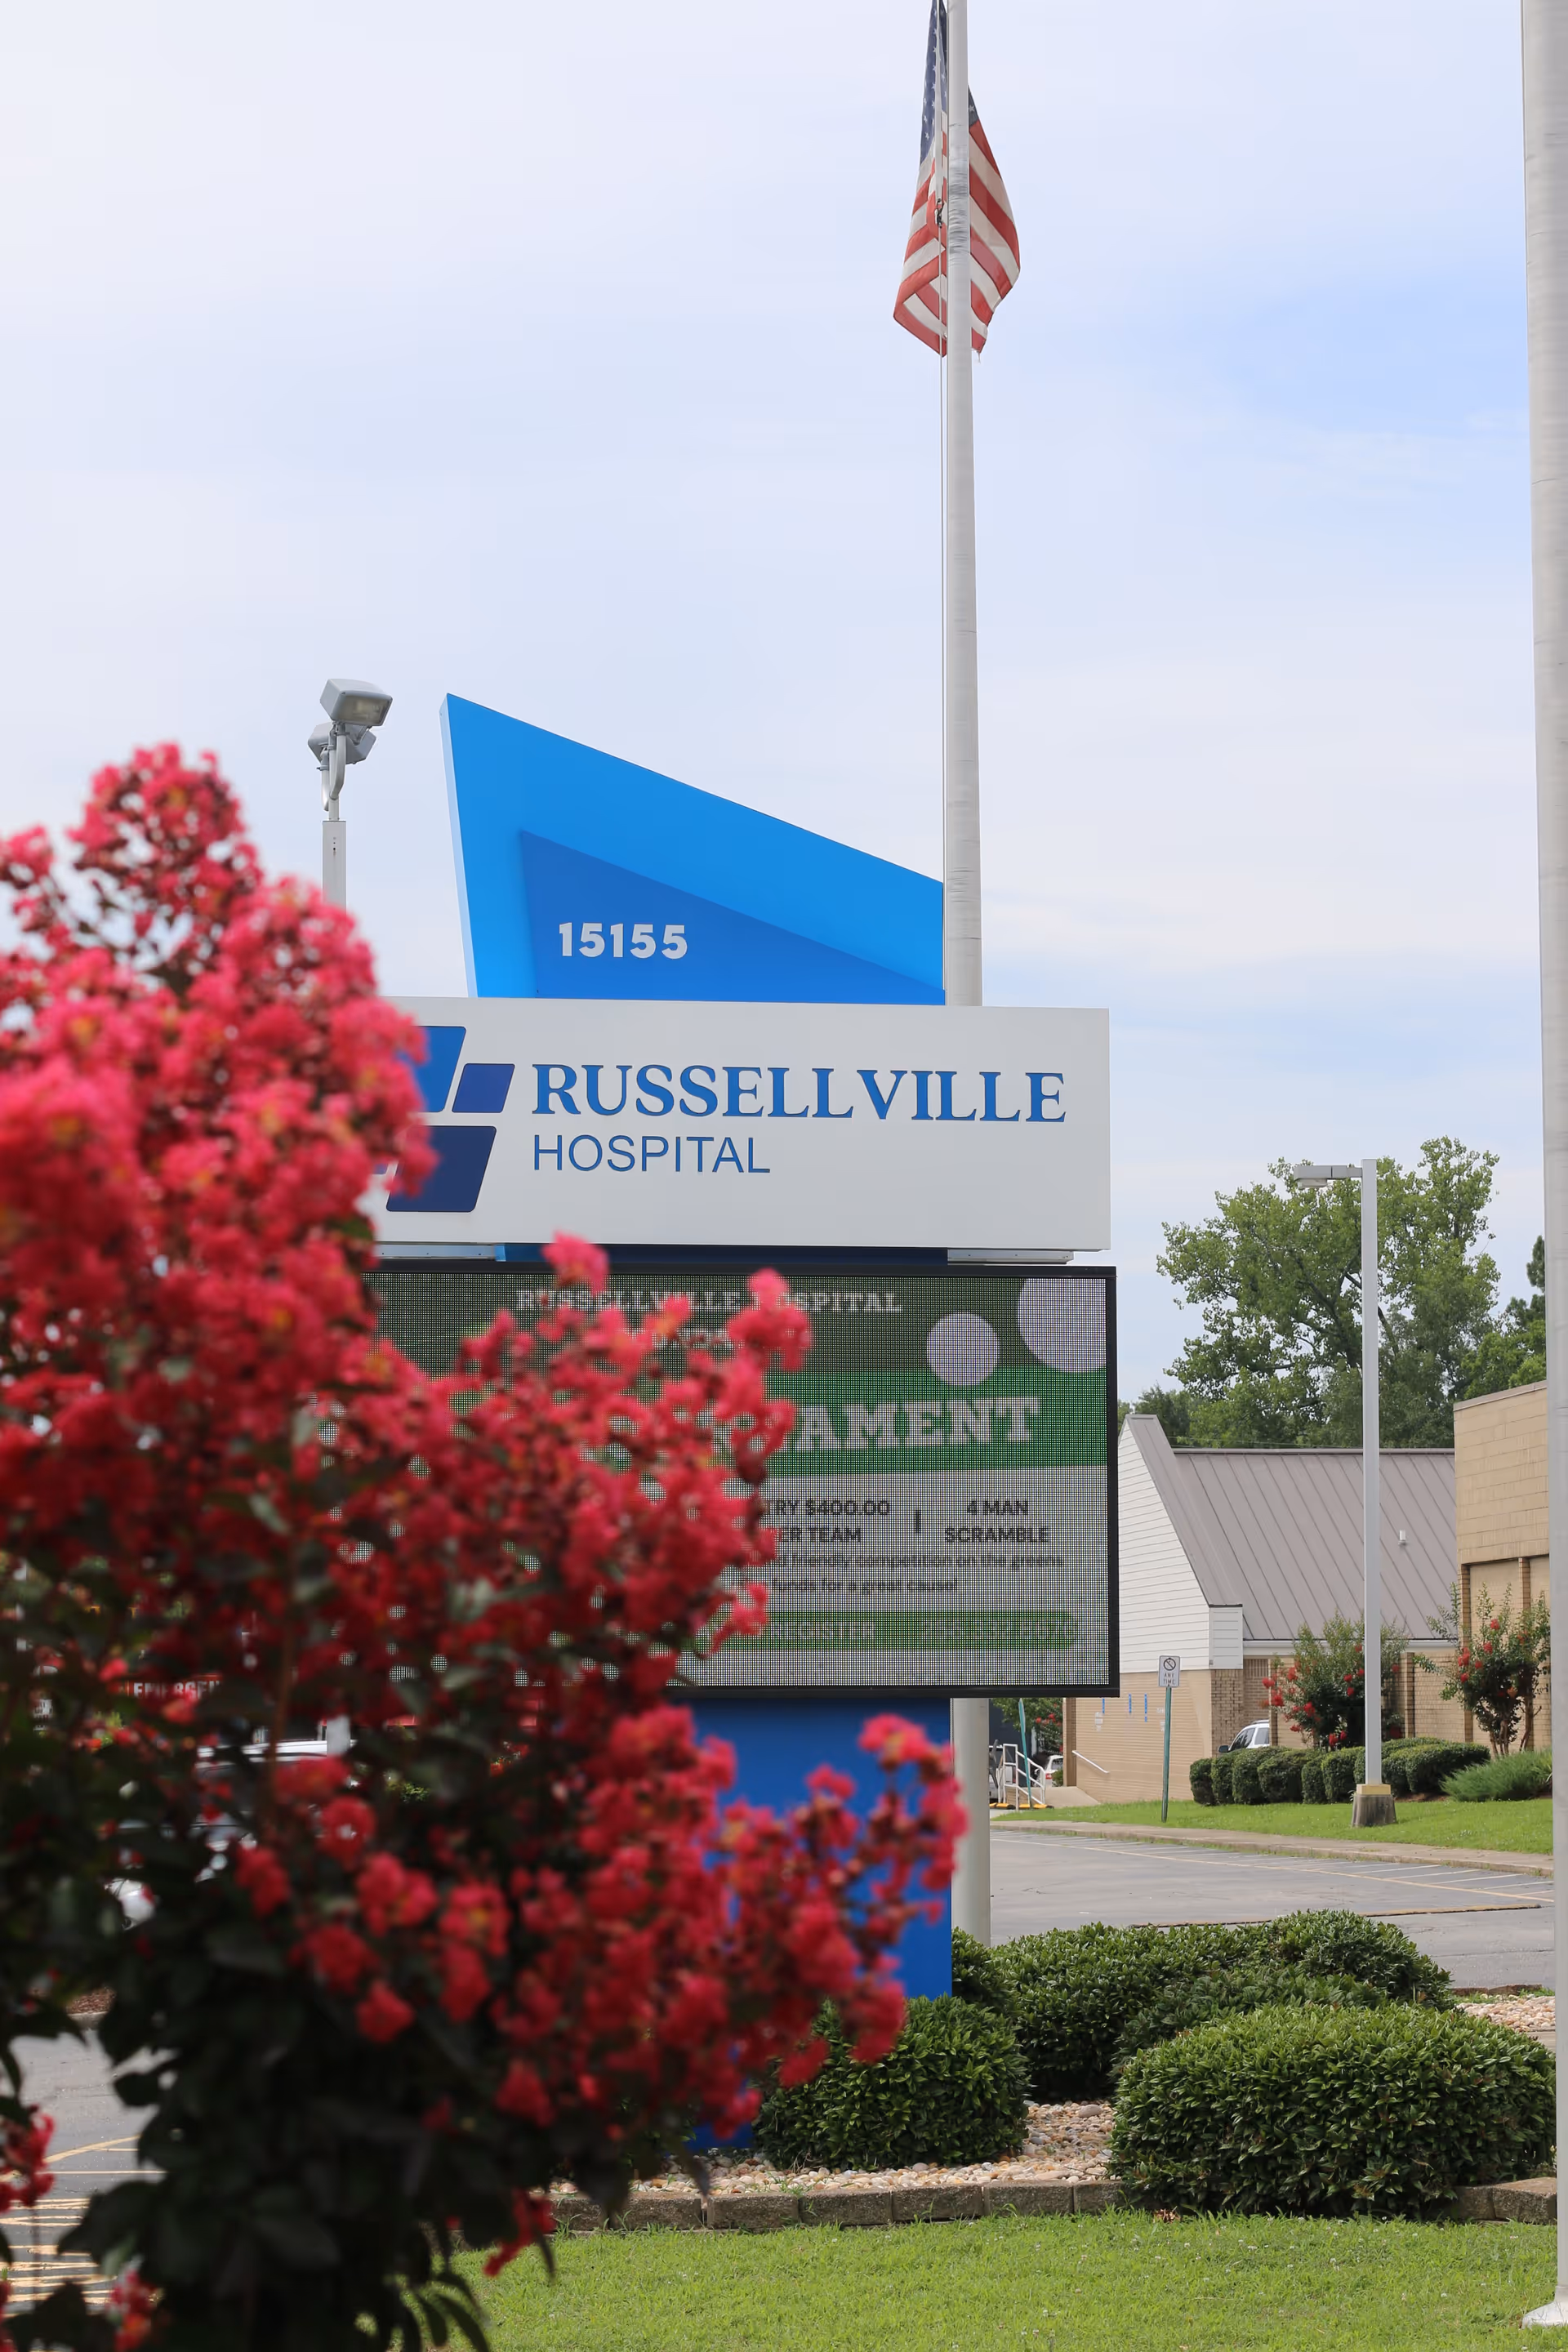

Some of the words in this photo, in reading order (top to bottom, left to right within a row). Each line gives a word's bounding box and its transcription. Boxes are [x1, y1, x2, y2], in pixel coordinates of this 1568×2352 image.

[559, 921, 688, 960] 15155
[532, 1063, 1067, 1123] RUSSELLVILLE
[534, 1134, 771, 1174] HOSPITAL
[516, 1290, 741, 1311] RUSSELLVLLE
[805, 1499, 891, 1517] $400.00
[966, 1499, 978, 1517] 4
[982, 1499, 1029, 1517] MAN
[807, 1526, 862, 1544] TEAM
[944, 1526, 1050, 1544] SCRAMBLE
[791, 1552, 852, 1570] friendly
[855, 1553, 953, 1570] competition
[956, 1556, 977, 1568] on
[981, 1553, 1007, 1568] the
[1009, 1555, 1064, 1571] greens
[772, 1578, 816, 1592] funds
[821, 1578, 844, 1592] for
[847, 1581, 858, 1592] a
[862, 1579, 902, 1596] great
[906, 1577, 959, 1593] cause!
[769, 1620, 877, 1641] REGISTER
